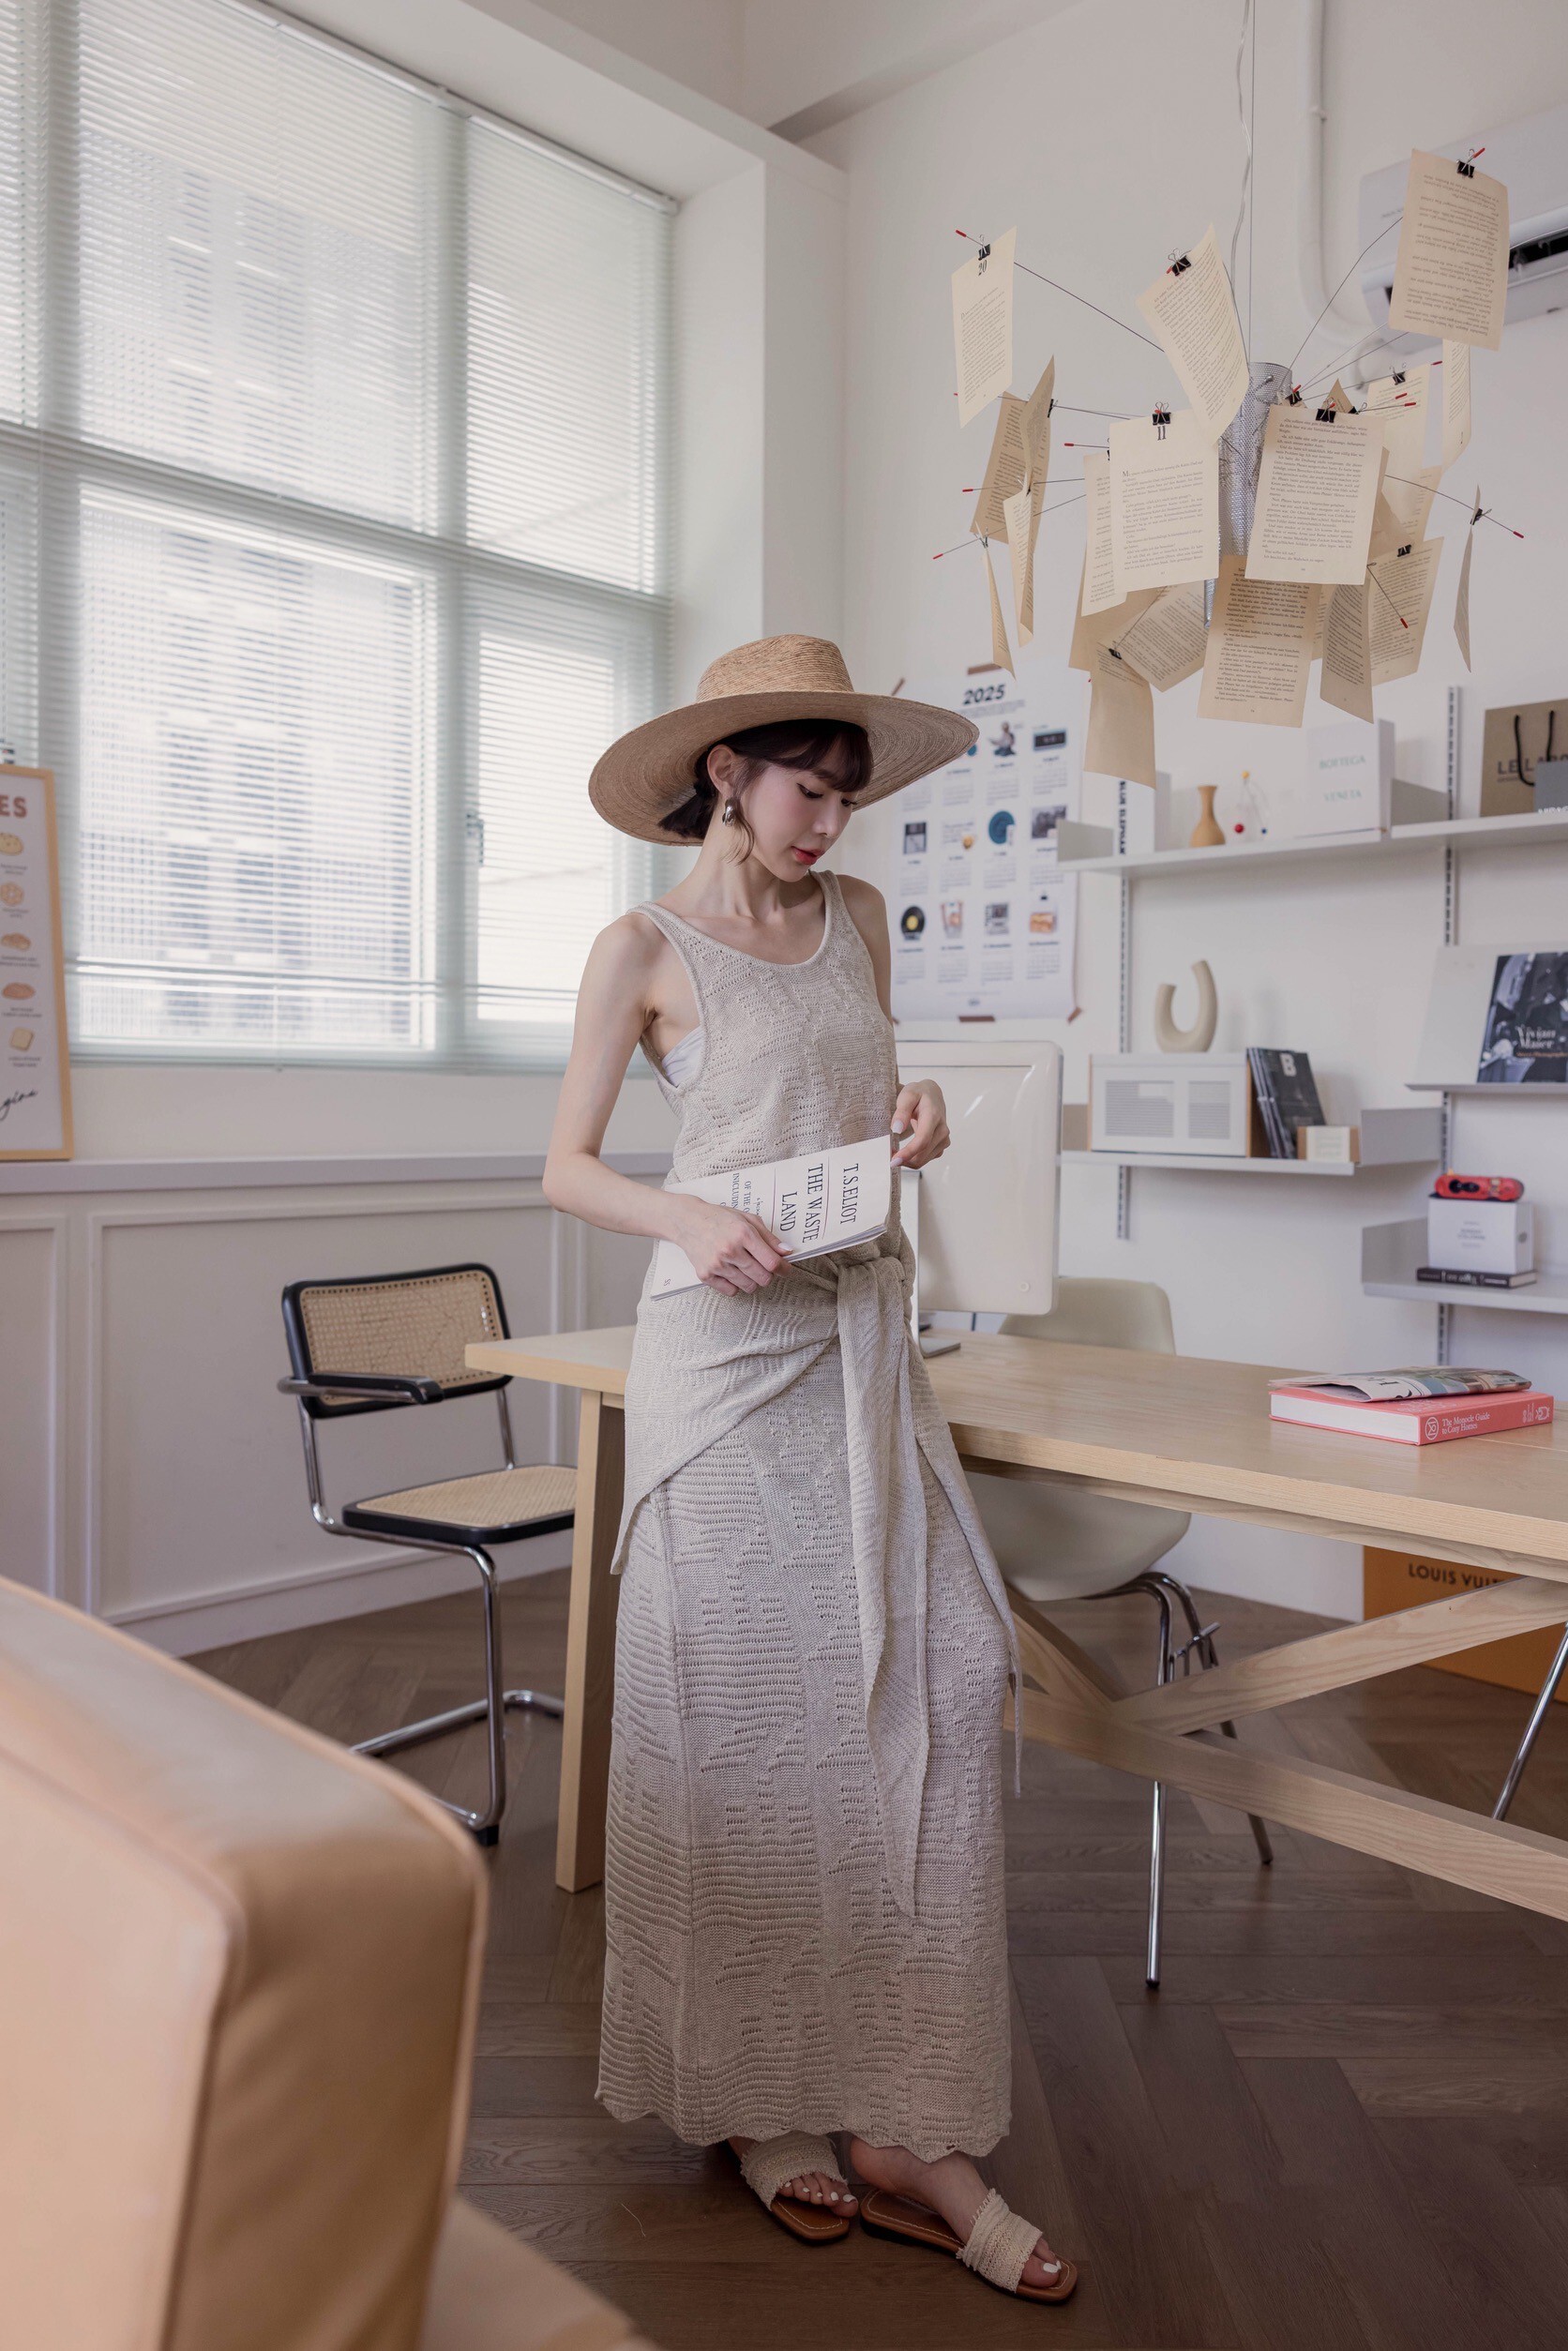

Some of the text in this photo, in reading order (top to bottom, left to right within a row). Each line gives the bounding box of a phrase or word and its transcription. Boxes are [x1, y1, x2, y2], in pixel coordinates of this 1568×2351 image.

[963, 684, 1005, 705] 2025
[1280, 1053, 1297, 1077] B
[744, 1181, 751, 1190] OF
[743, 1192, 751, 1206] THE
[802, 1163, 823, 1243] THE WASTE
[779, 1191, 797, 1231] LAND
[1442, 1412, 1490, 1426] The Monocle Guide
[1448, 1425, 1460, 1434] Cozy
[1461, 1423, 1478, 1431] Homes
[1409, 1563, 1456, 1585] LOUIS
